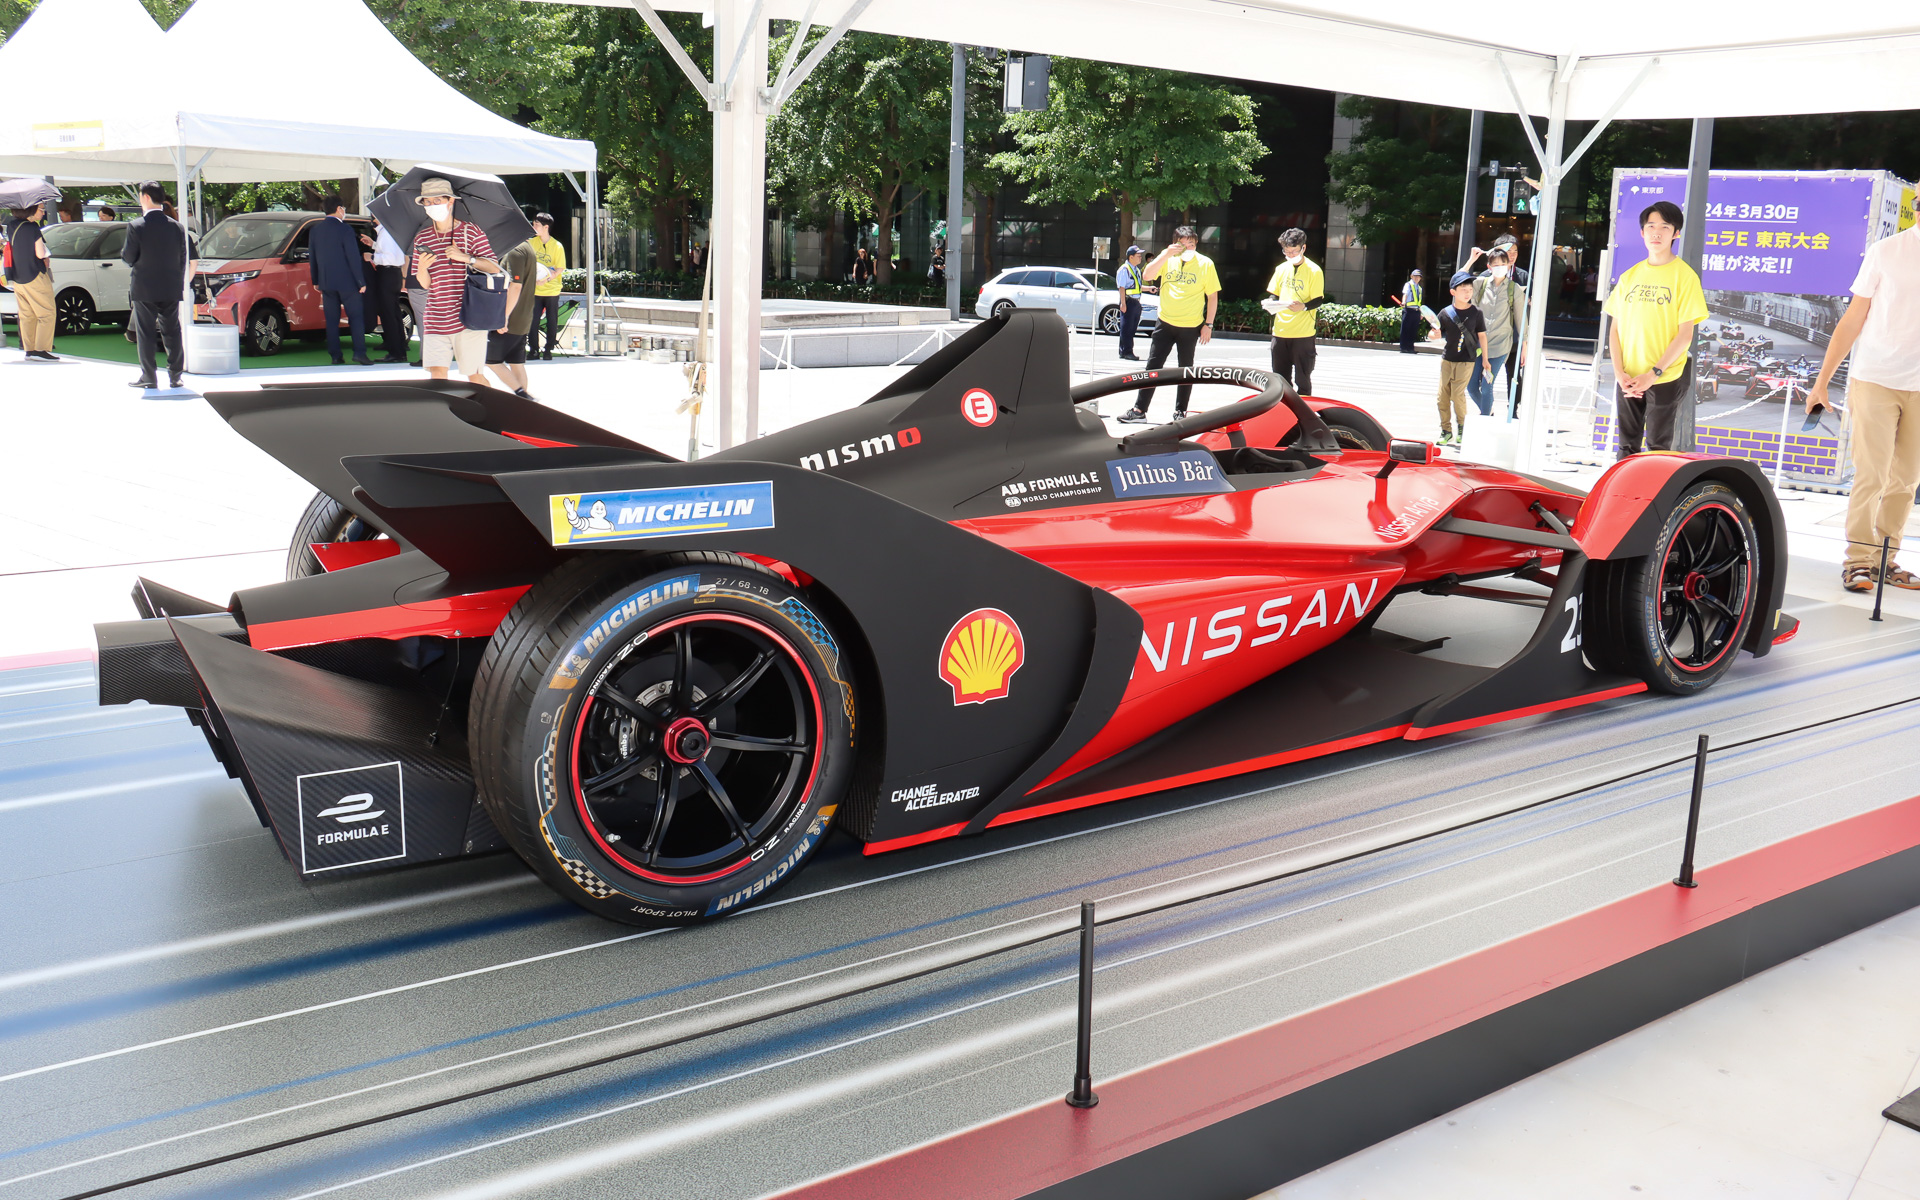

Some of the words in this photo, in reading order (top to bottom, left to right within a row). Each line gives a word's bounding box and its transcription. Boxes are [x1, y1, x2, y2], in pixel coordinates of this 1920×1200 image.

[1641, 186, 1664, 194] 東京都
[1755, 230, 1830, 250] 東京大会
[1183, 366, 1243, 385] Nissan
[799, 426, 922, 471] nismo
[1001, 482, 1028, 497] ABB
[1029, 473, 1085, 493] FORMULA
[1088, 471, 1099, 483] E
[1116, 465, 1178, 491] Julius
[1180, 460, 1214, 482] Bär
[1021, 492, 1049, 504] WORLD
[1049, 486, 1102, 499] CHAMPIONSHIP
[617, 498, 755, 525] MICHELIN
[1374, 512, 1419, 540] Nissan
[582, 579, 690, 655] MICHELIN
[1130, 577, 1379, 680] NISSAN
[317, 826, 379, 846] FORMULA
[381, 824, 390, 835] E
[716, 837, 811, 911] MICHELIN
[630, 905, 666, 917] SPORT
[667, 909, 699, 917] PILOT
